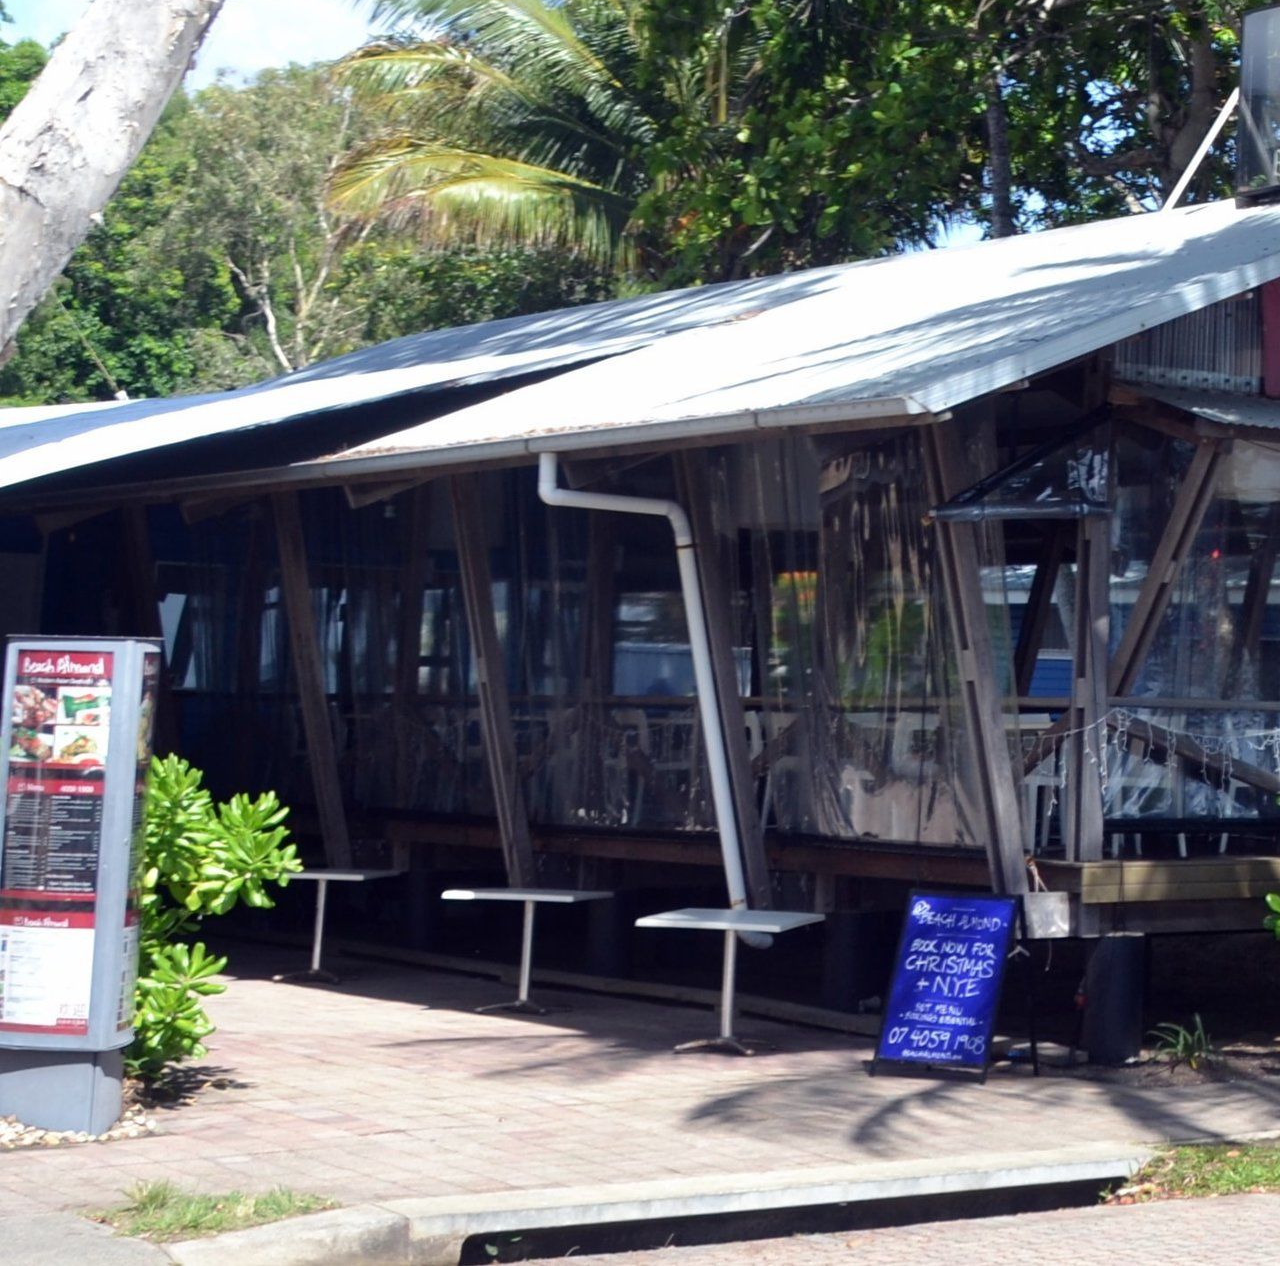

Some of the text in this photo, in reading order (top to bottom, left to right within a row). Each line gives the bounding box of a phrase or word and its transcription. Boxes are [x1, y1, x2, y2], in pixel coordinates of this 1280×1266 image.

[22, 654, 105, 675] Beach Almond
[919, 911, 1001, 932] BEACH ALMOND
[940, 940, 968, 955] NOW
[971, 942, 997, 959] FOR
[905, 955, 995, 978] CHRISTMAS
[888, 1026, 985, 1055] 07 4059 1908
